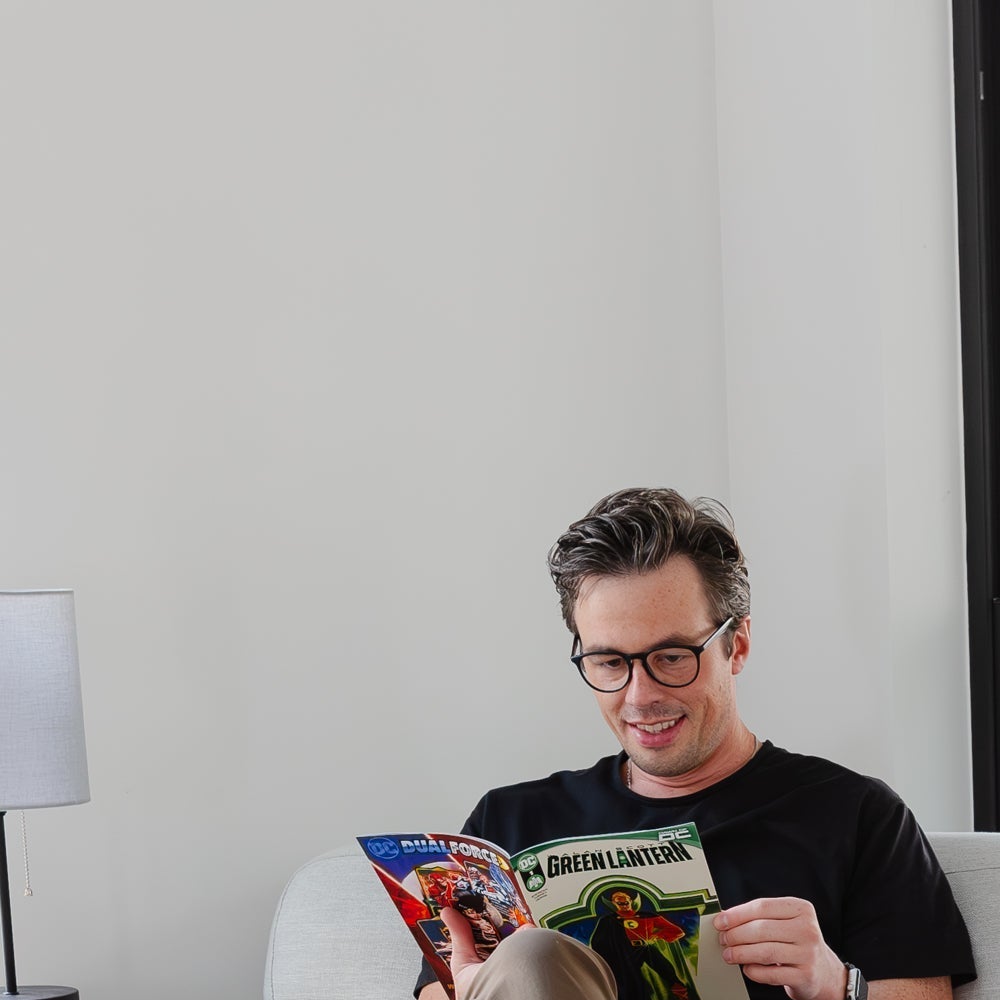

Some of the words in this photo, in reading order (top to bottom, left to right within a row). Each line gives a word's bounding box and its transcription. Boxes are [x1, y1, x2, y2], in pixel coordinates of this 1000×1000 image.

[370, 839, 398, 857] DC
[518, 854, 537, 870] DC
[547, 852, 606, 878] GREEN
[605, 841, 692, 868] LANTERN
